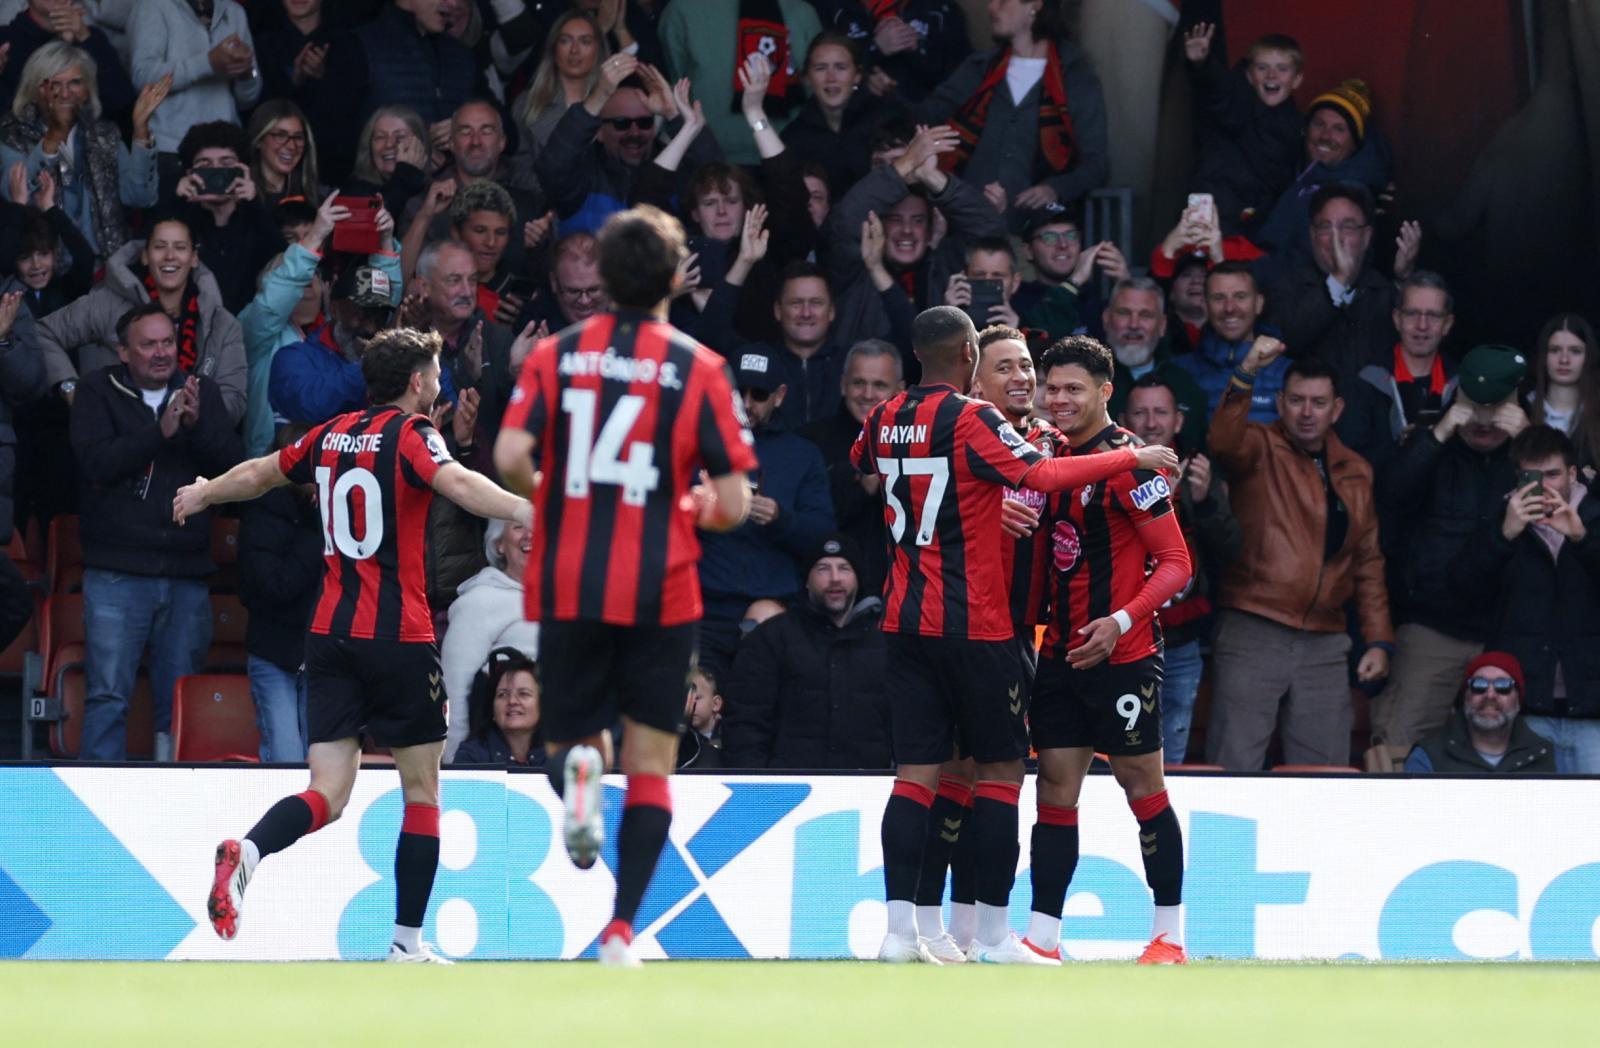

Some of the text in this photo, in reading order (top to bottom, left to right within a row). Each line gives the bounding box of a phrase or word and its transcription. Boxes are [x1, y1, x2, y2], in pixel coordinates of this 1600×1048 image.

[558, 347, 659, 384] ANTÓNIO
[322, 432, 383, 453] CHRISTIE
[562, 388, 659, 507] 14
[880, 425, 927, 444] RAYAN
[875, 457, 950, 546] 37
[1130, 476, 1169, 508] MrQ
[315, 466, 383, 560] 10
[34, 700, 42, 716] D
[1116, 693, 1142, 731] 9
